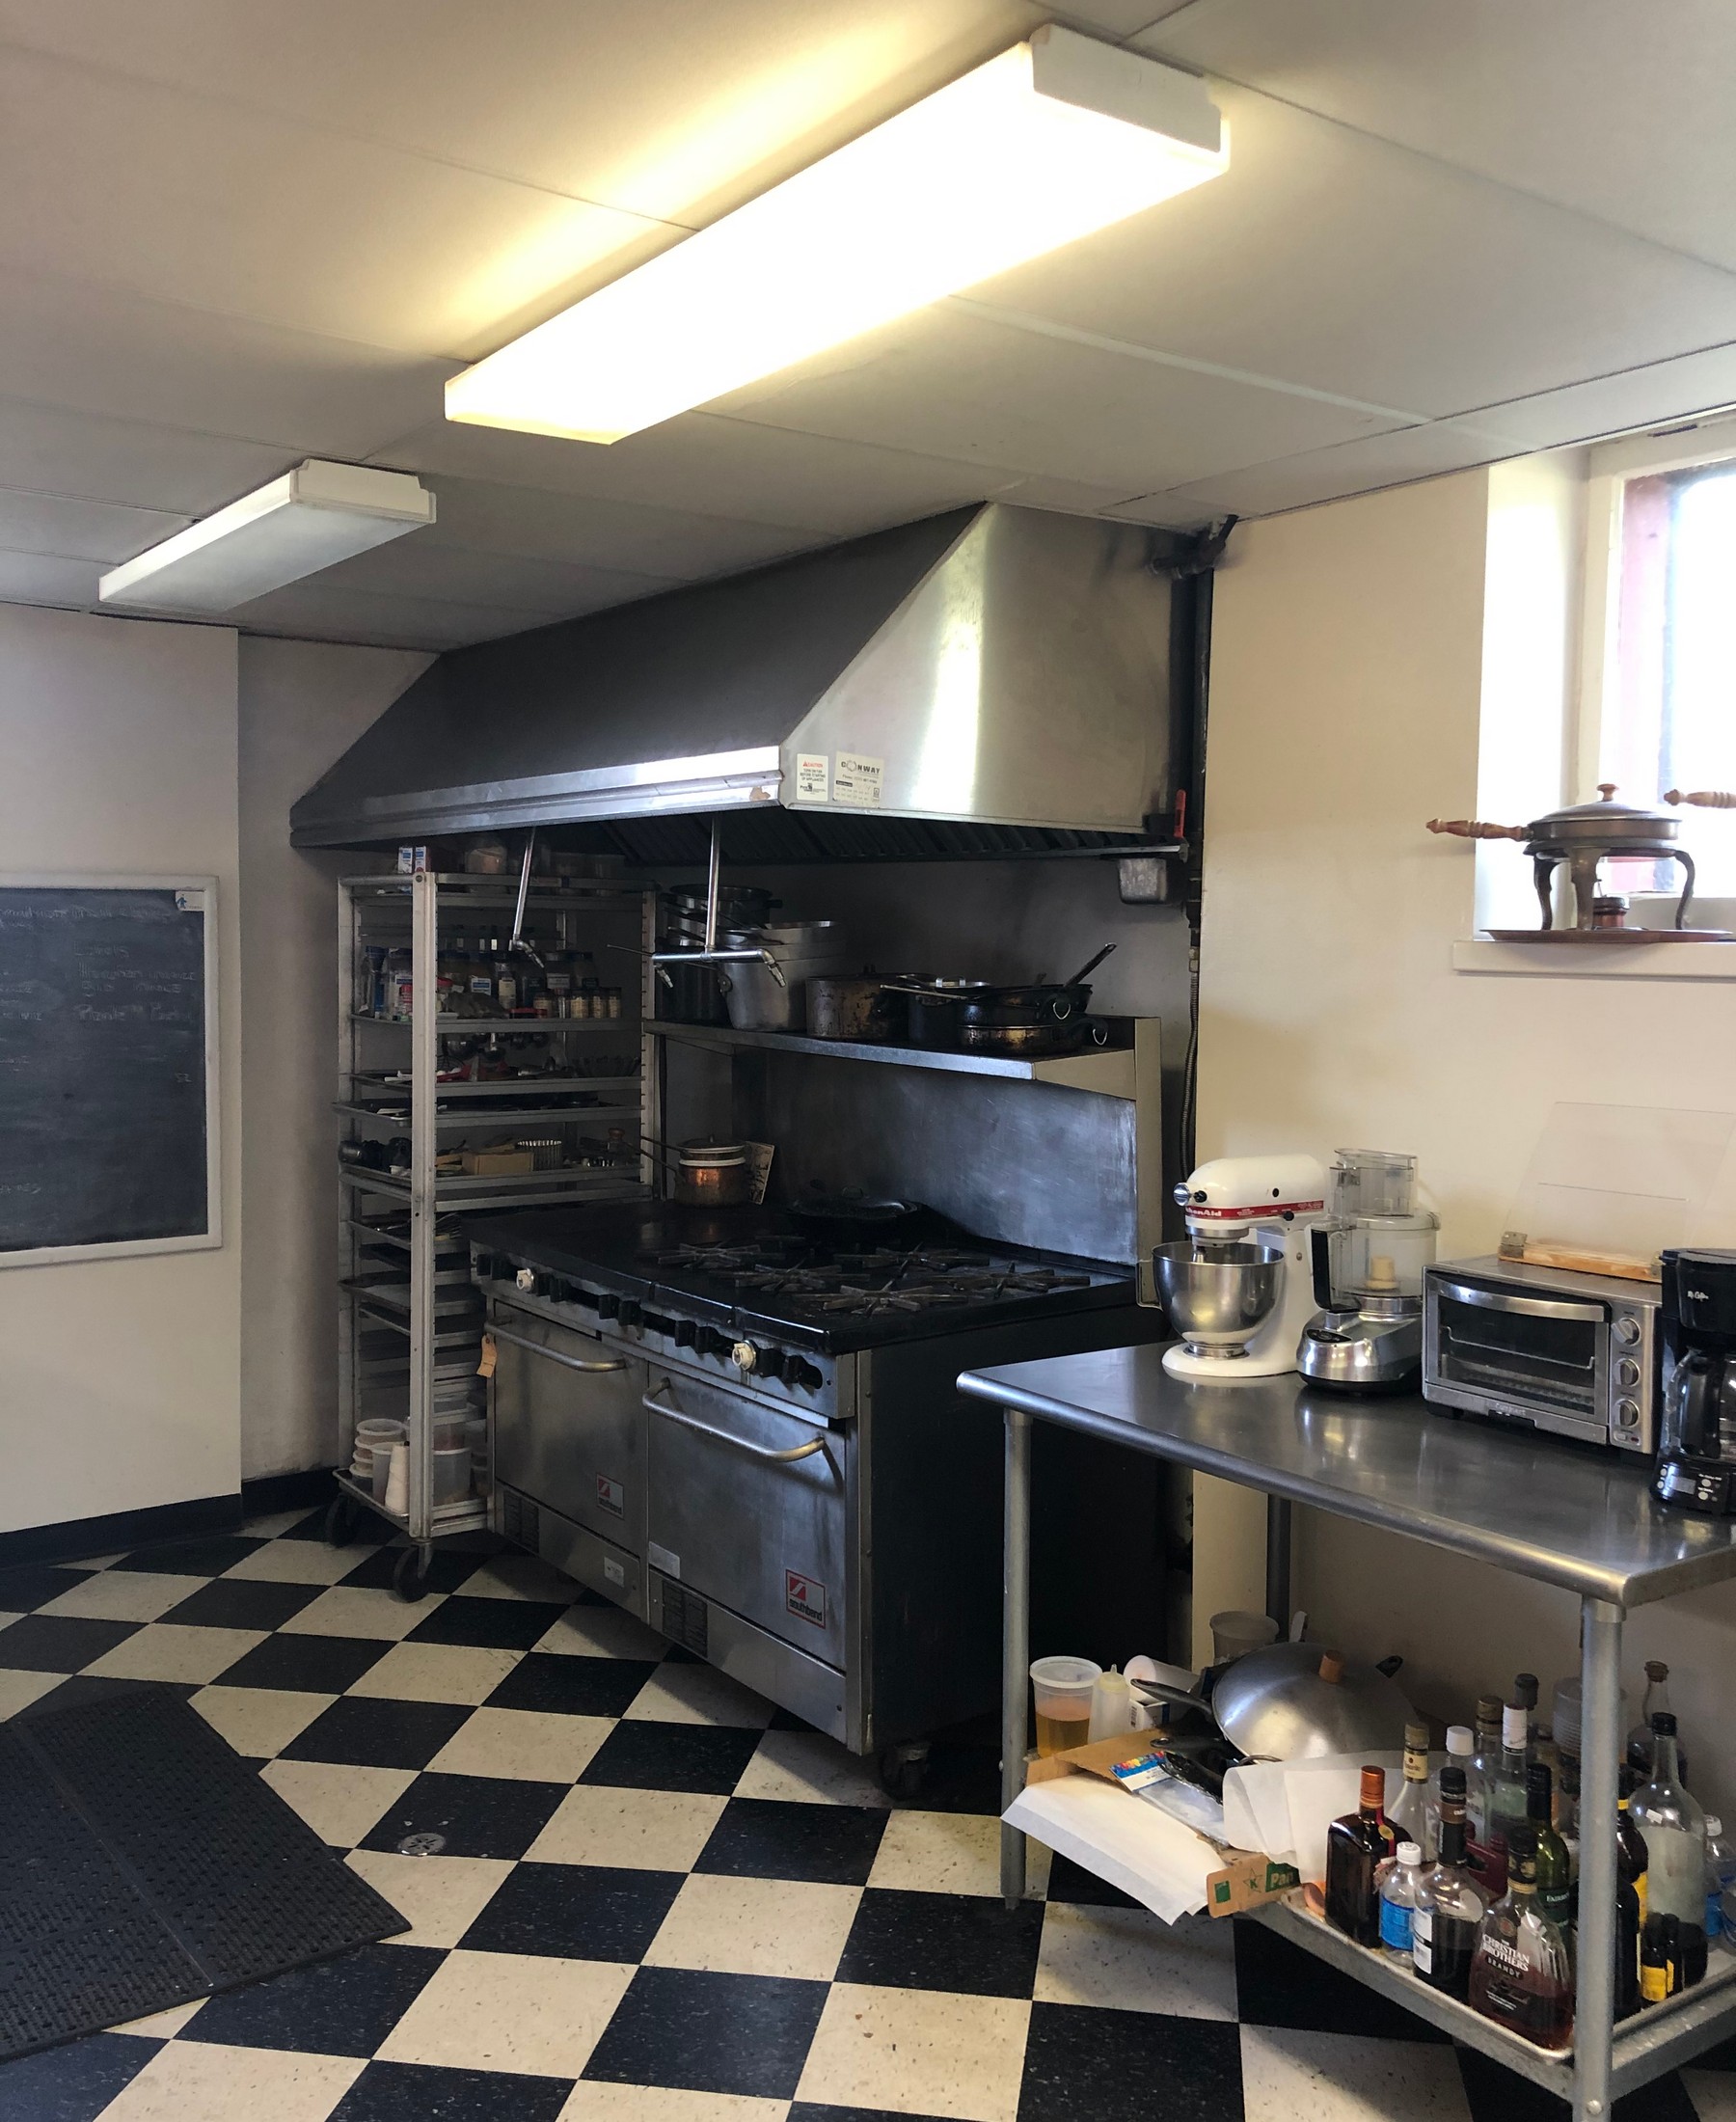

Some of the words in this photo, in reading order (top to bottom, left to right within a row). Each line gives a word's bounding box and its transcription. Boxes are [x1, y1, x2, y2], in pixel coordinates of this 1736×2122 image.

[841, 760, 880, 774] CONWAY
[1482, 1933, 1530, 1964] CHRISTIAN
[1482, 1942, 1529, 1972] BROTHERS
[1487, 1956, 1521, 1979] BRANDY
